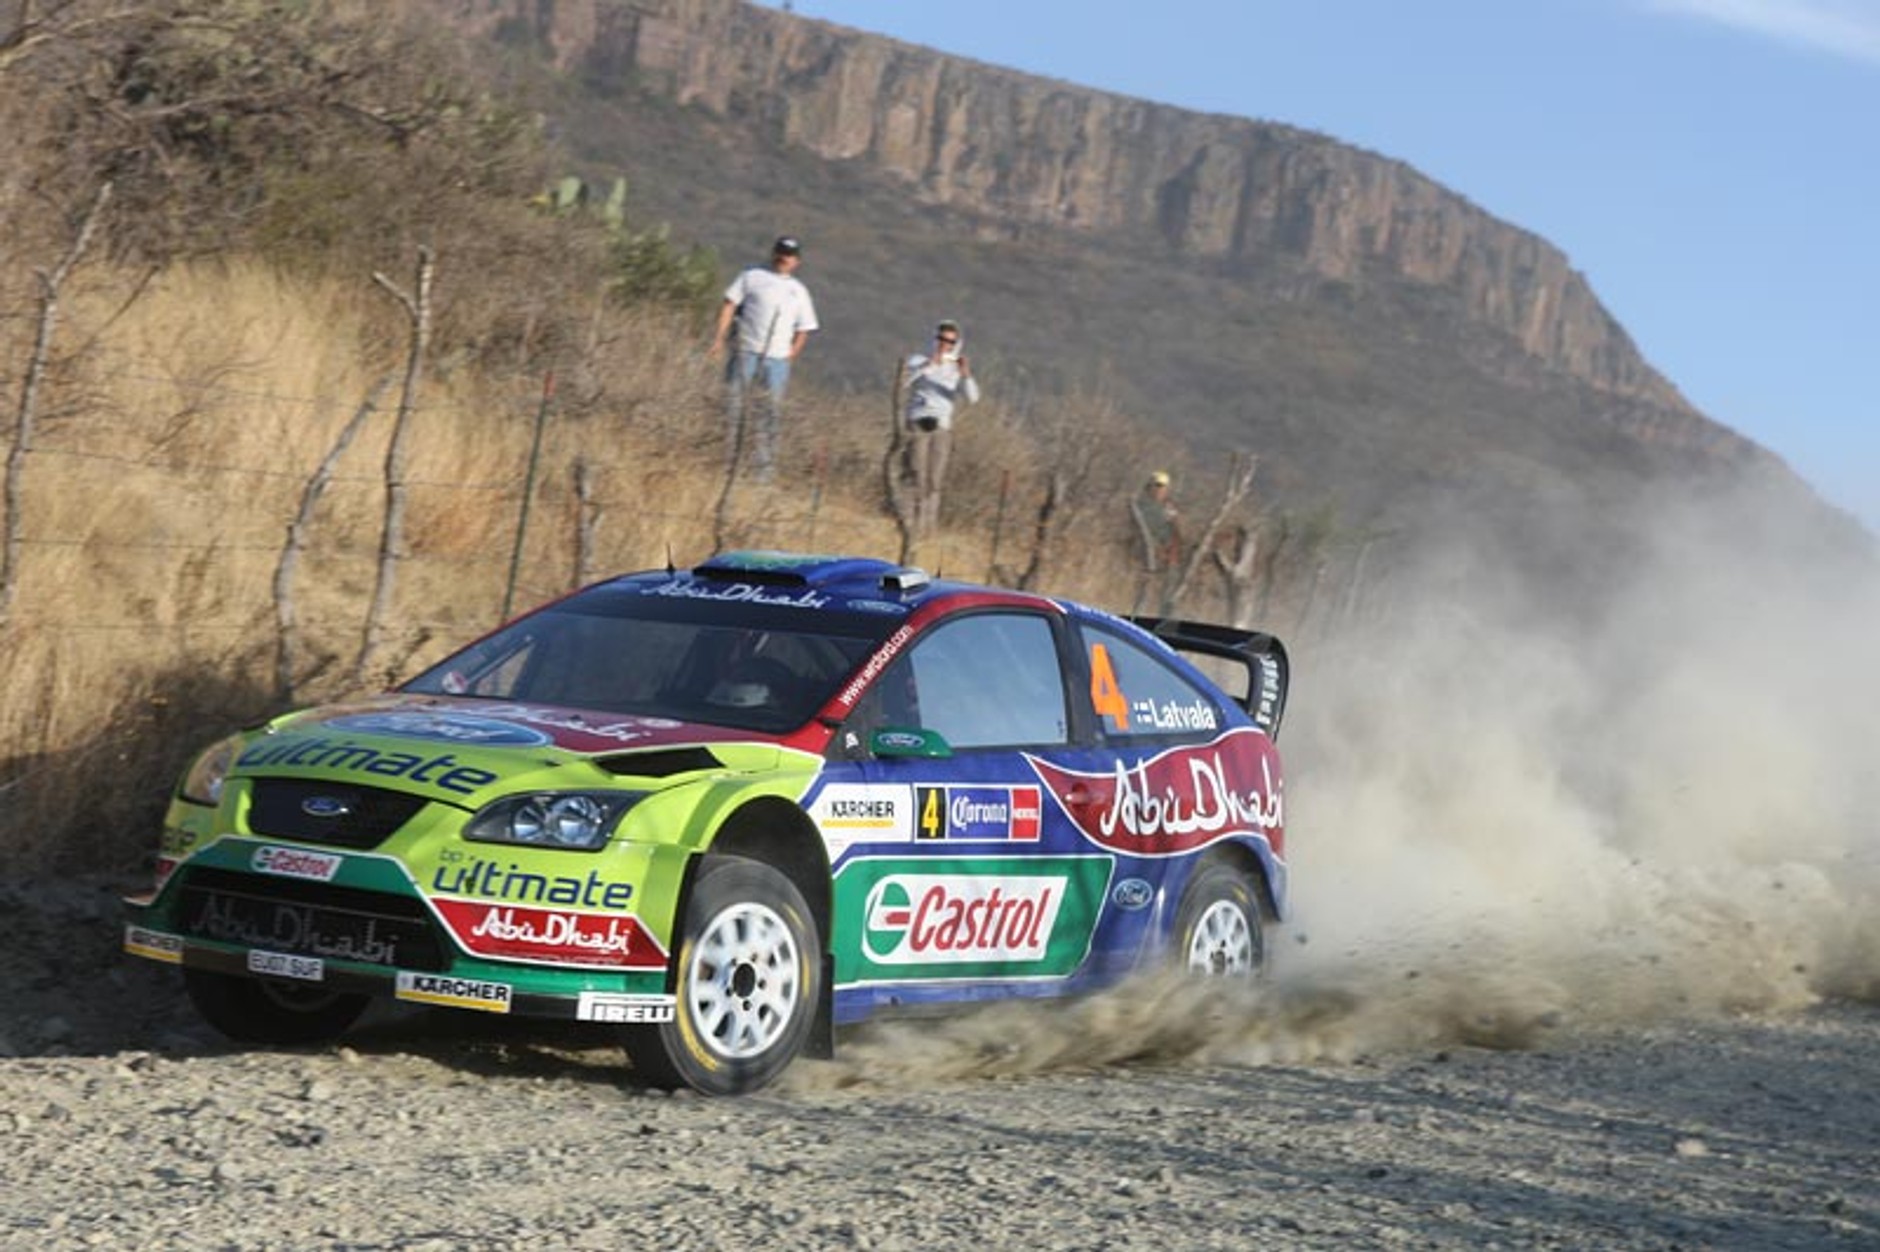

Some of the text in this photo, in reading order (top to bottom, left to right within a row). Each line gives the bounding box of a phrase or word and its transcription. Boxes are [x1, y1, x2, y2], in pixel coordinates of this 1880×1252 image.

[1090, 643, 1129, 731] 4
[1148, 698, 1217, 730] Latvala
[235, 736, 499, 794] ultimate
[922, 788, 939, 837] 4
[952, 796, 1007, 831] Corona
[1100, 758, 1186, 836] Abu
[270, 849, 336, 877] Castrol
[432, 859, 633, 909] ultimate
[910, 885, 1050, 952] Castrol
